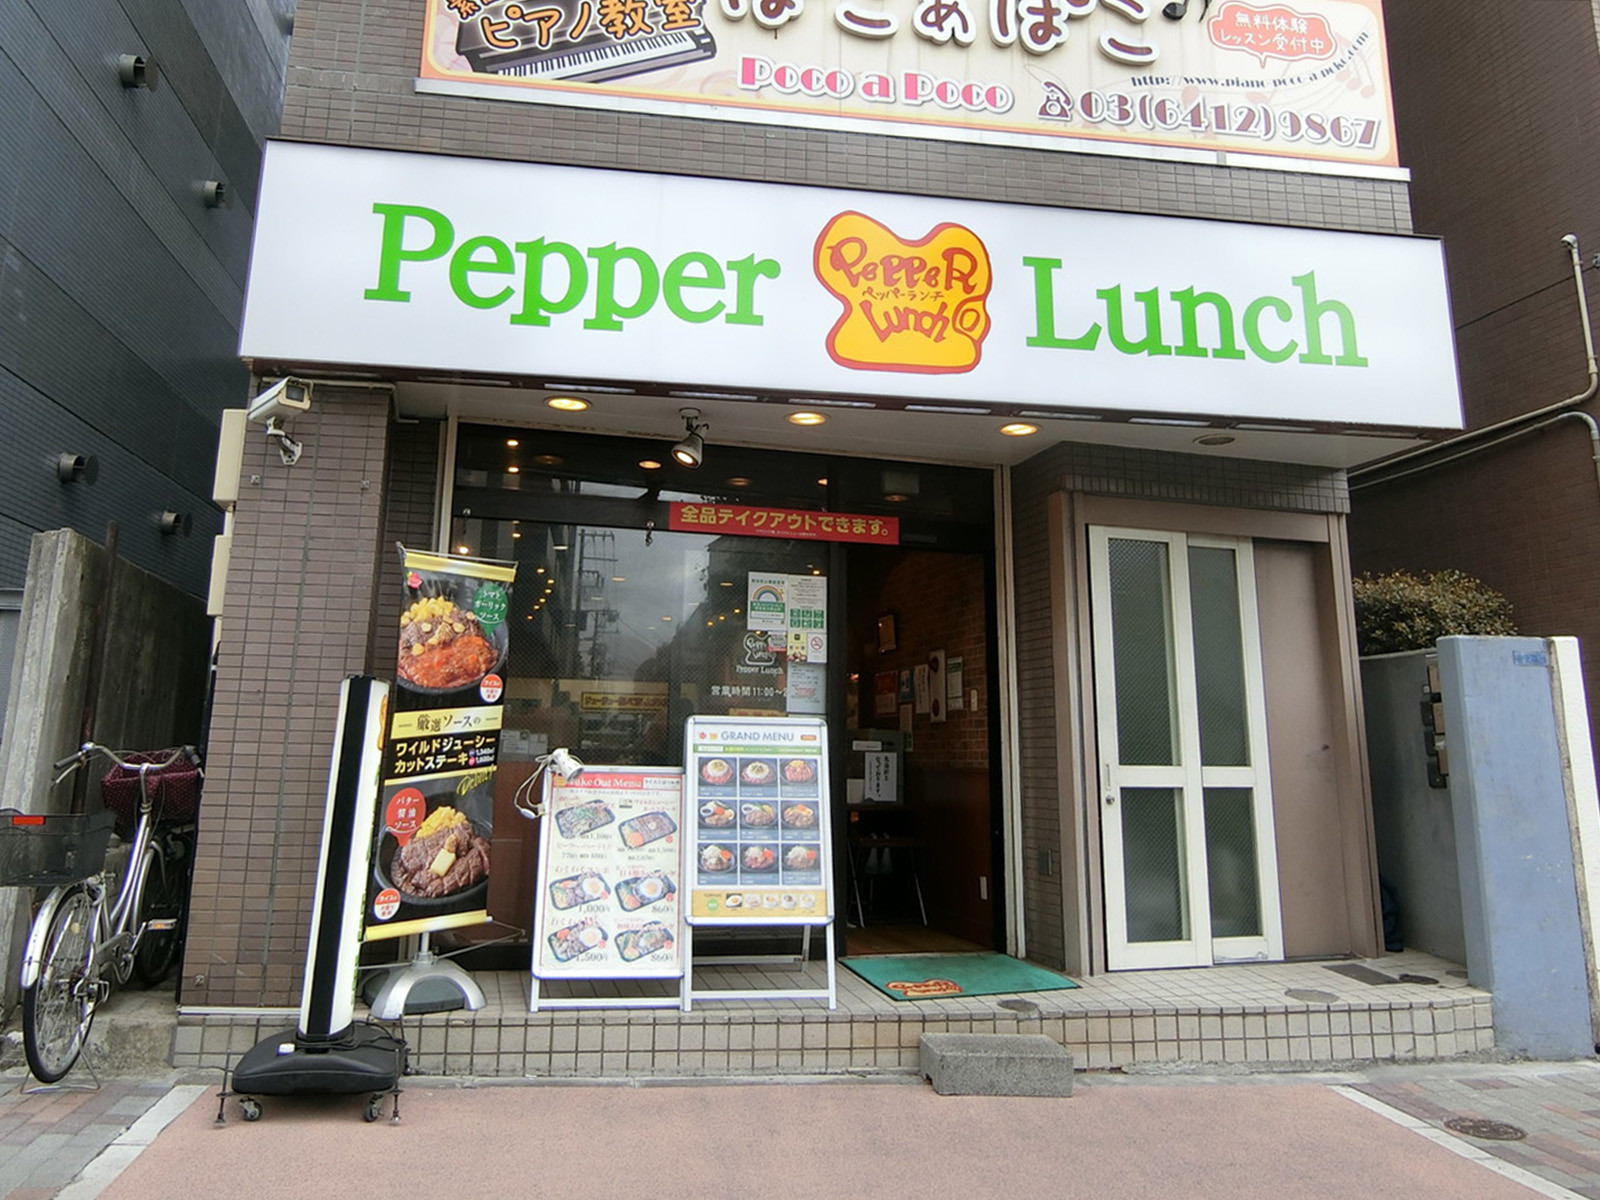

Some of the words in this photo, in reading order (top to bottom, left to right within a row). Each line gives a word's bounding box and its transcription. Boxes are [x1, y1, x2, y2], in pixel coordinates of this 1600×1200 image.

[1234, 11, 1309, 35] 無料体験
[1219, 29, 1325, 54] レッスン受付中
[860, 73, 892, 99] a
[1079, 91, 1379, 147] 03(6412)9867
[364, 203, 781, 331] Pepper
[861, 286, 945, 301] ペッパーランチ
[1022, 256, 1368, 367] Lunch
[680, 504, 889, 536] 全品テイクアウトできます。
[417, 714, 482, 733] 厳選ソースの
[396, 735, 496, 757] ワイルドジューシー
[721, 731, 760, 741] GRAND
[763, 732, 795, 741] MENU
[394, 751, 469, 774] カットステーキ
[593, 778, 612, 788] Out
[613, 778, 642, 788] Menu
[395, 796, 420, 806] バター
